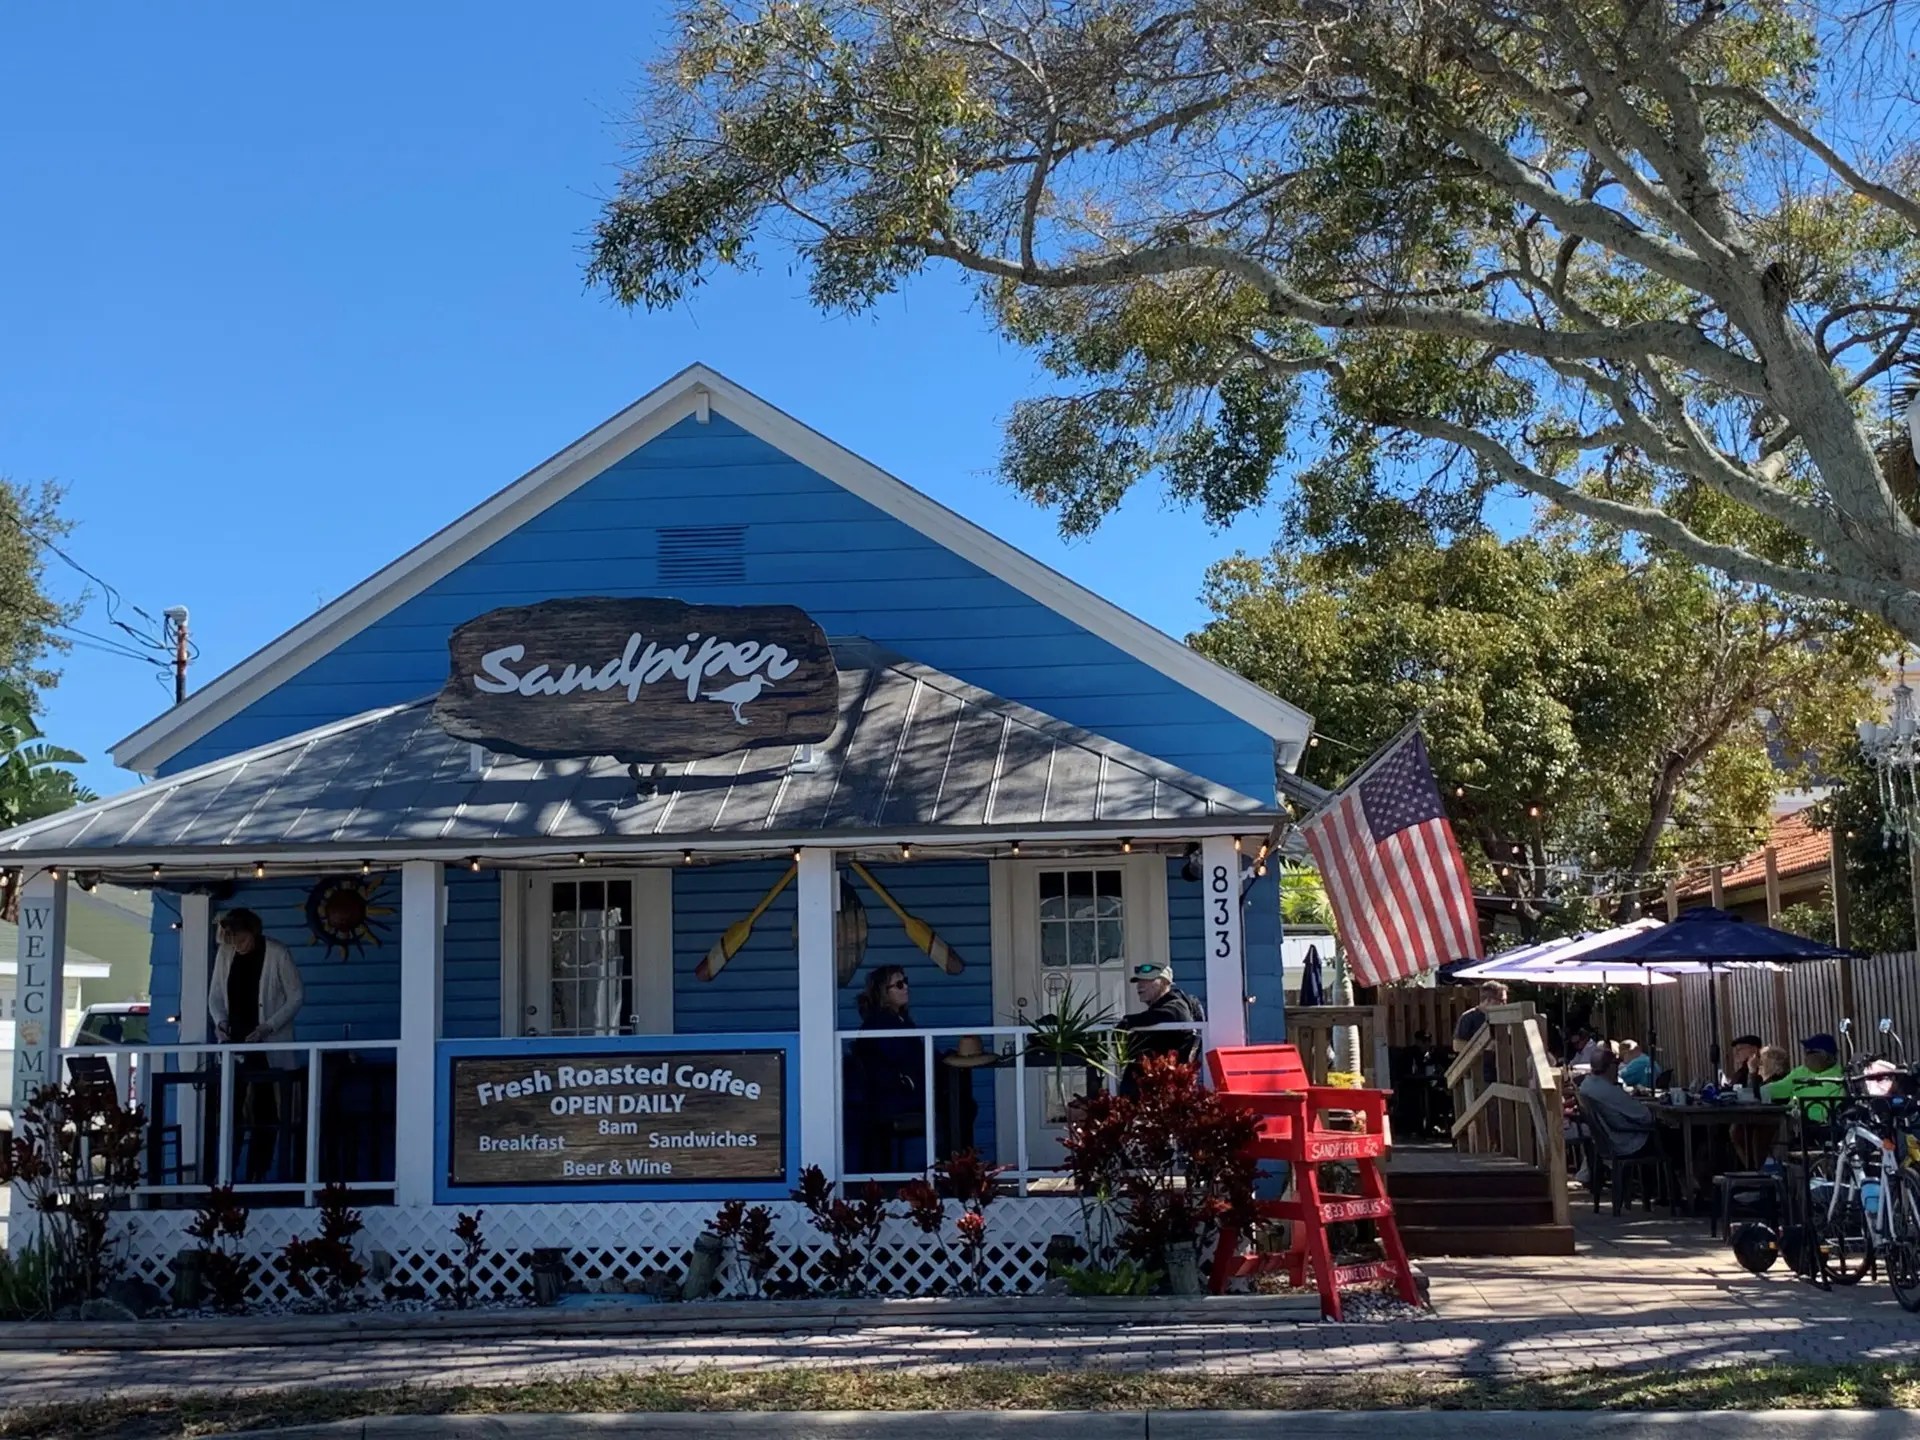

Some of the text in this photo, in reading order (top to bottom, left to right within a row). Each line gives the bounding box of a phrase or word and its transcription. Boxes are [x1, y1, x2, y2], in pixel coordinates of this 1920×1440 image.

[474, 632, 799, 703] Sandpiper
[1212, 866, 1231, 958] 833
[477, 1062, 761, 1106] Fresh Roasted Coffee
[551, 1094, 686, 1115] OPEN DAILY
[598, 1119, 638, 1135] 8am
[479, 1135, 566, 1152] Breakfast
[649, 1130, 757, 1149] Sandwiches
[1311, 1142, 1359, 1159] SANDPIPER
[563, 1158, 672, 1176] Beer & Wine
[1323, 1203, 1344, 1219] 833
[1334, 1265, 1378, 1284] DUNEDIN
